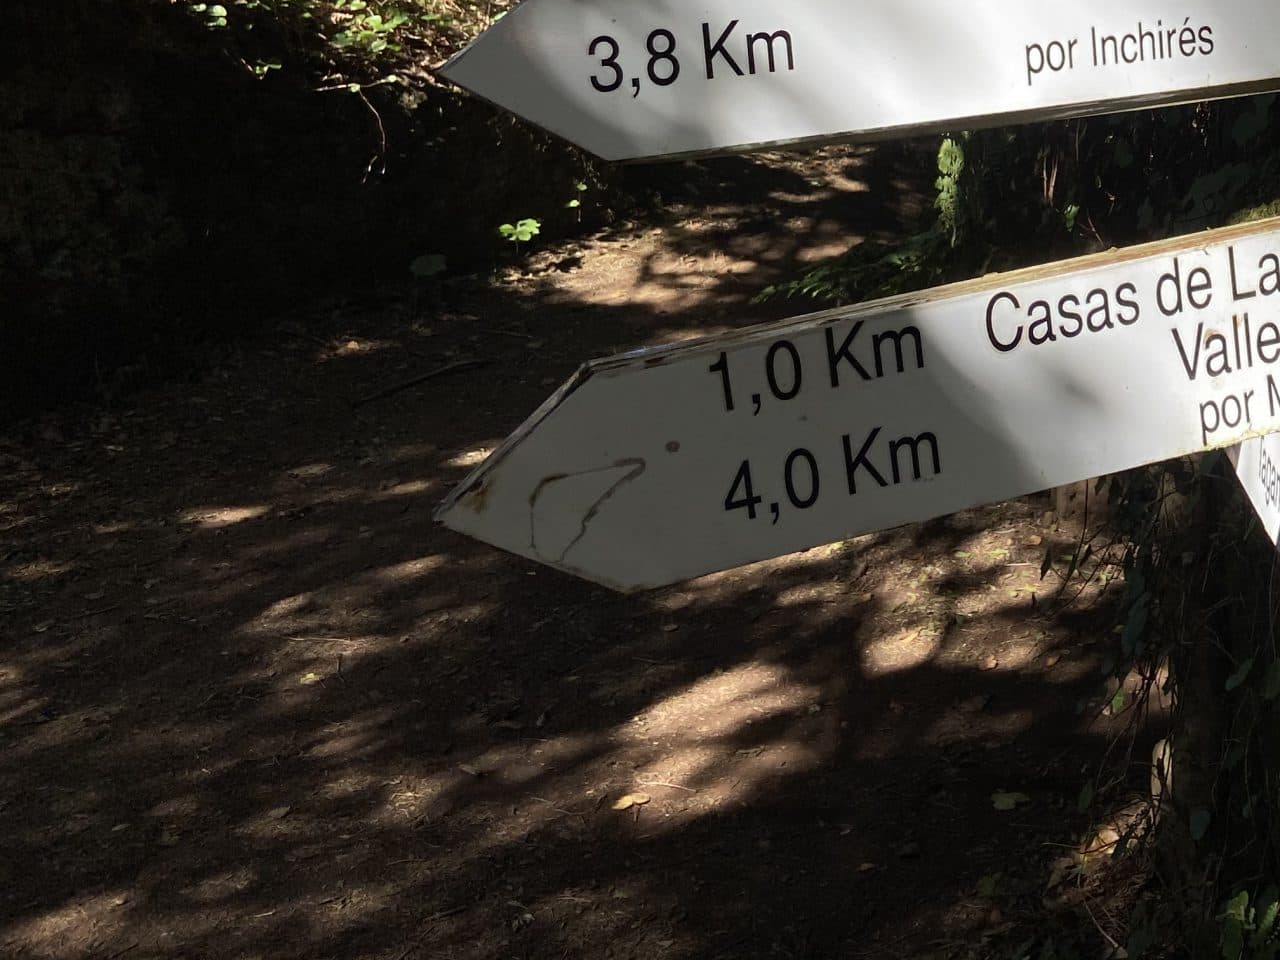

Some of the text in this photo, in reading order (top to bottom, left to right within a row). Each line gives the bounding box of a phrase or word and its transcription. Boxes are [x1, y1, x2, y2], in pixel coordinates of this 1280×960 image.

[588, 18, 795, 99] 3,8 Km
[1025, 16, 1215, 87] por Inchirés
[985, 281, 1141, 353] Casas
[1155, 256, 1213, 316] de
[708, 320, 926, 417] 1,0 Km
[1199, 388, 1255, 446] por
[724, 426, 942, 526] 4,0 Km
